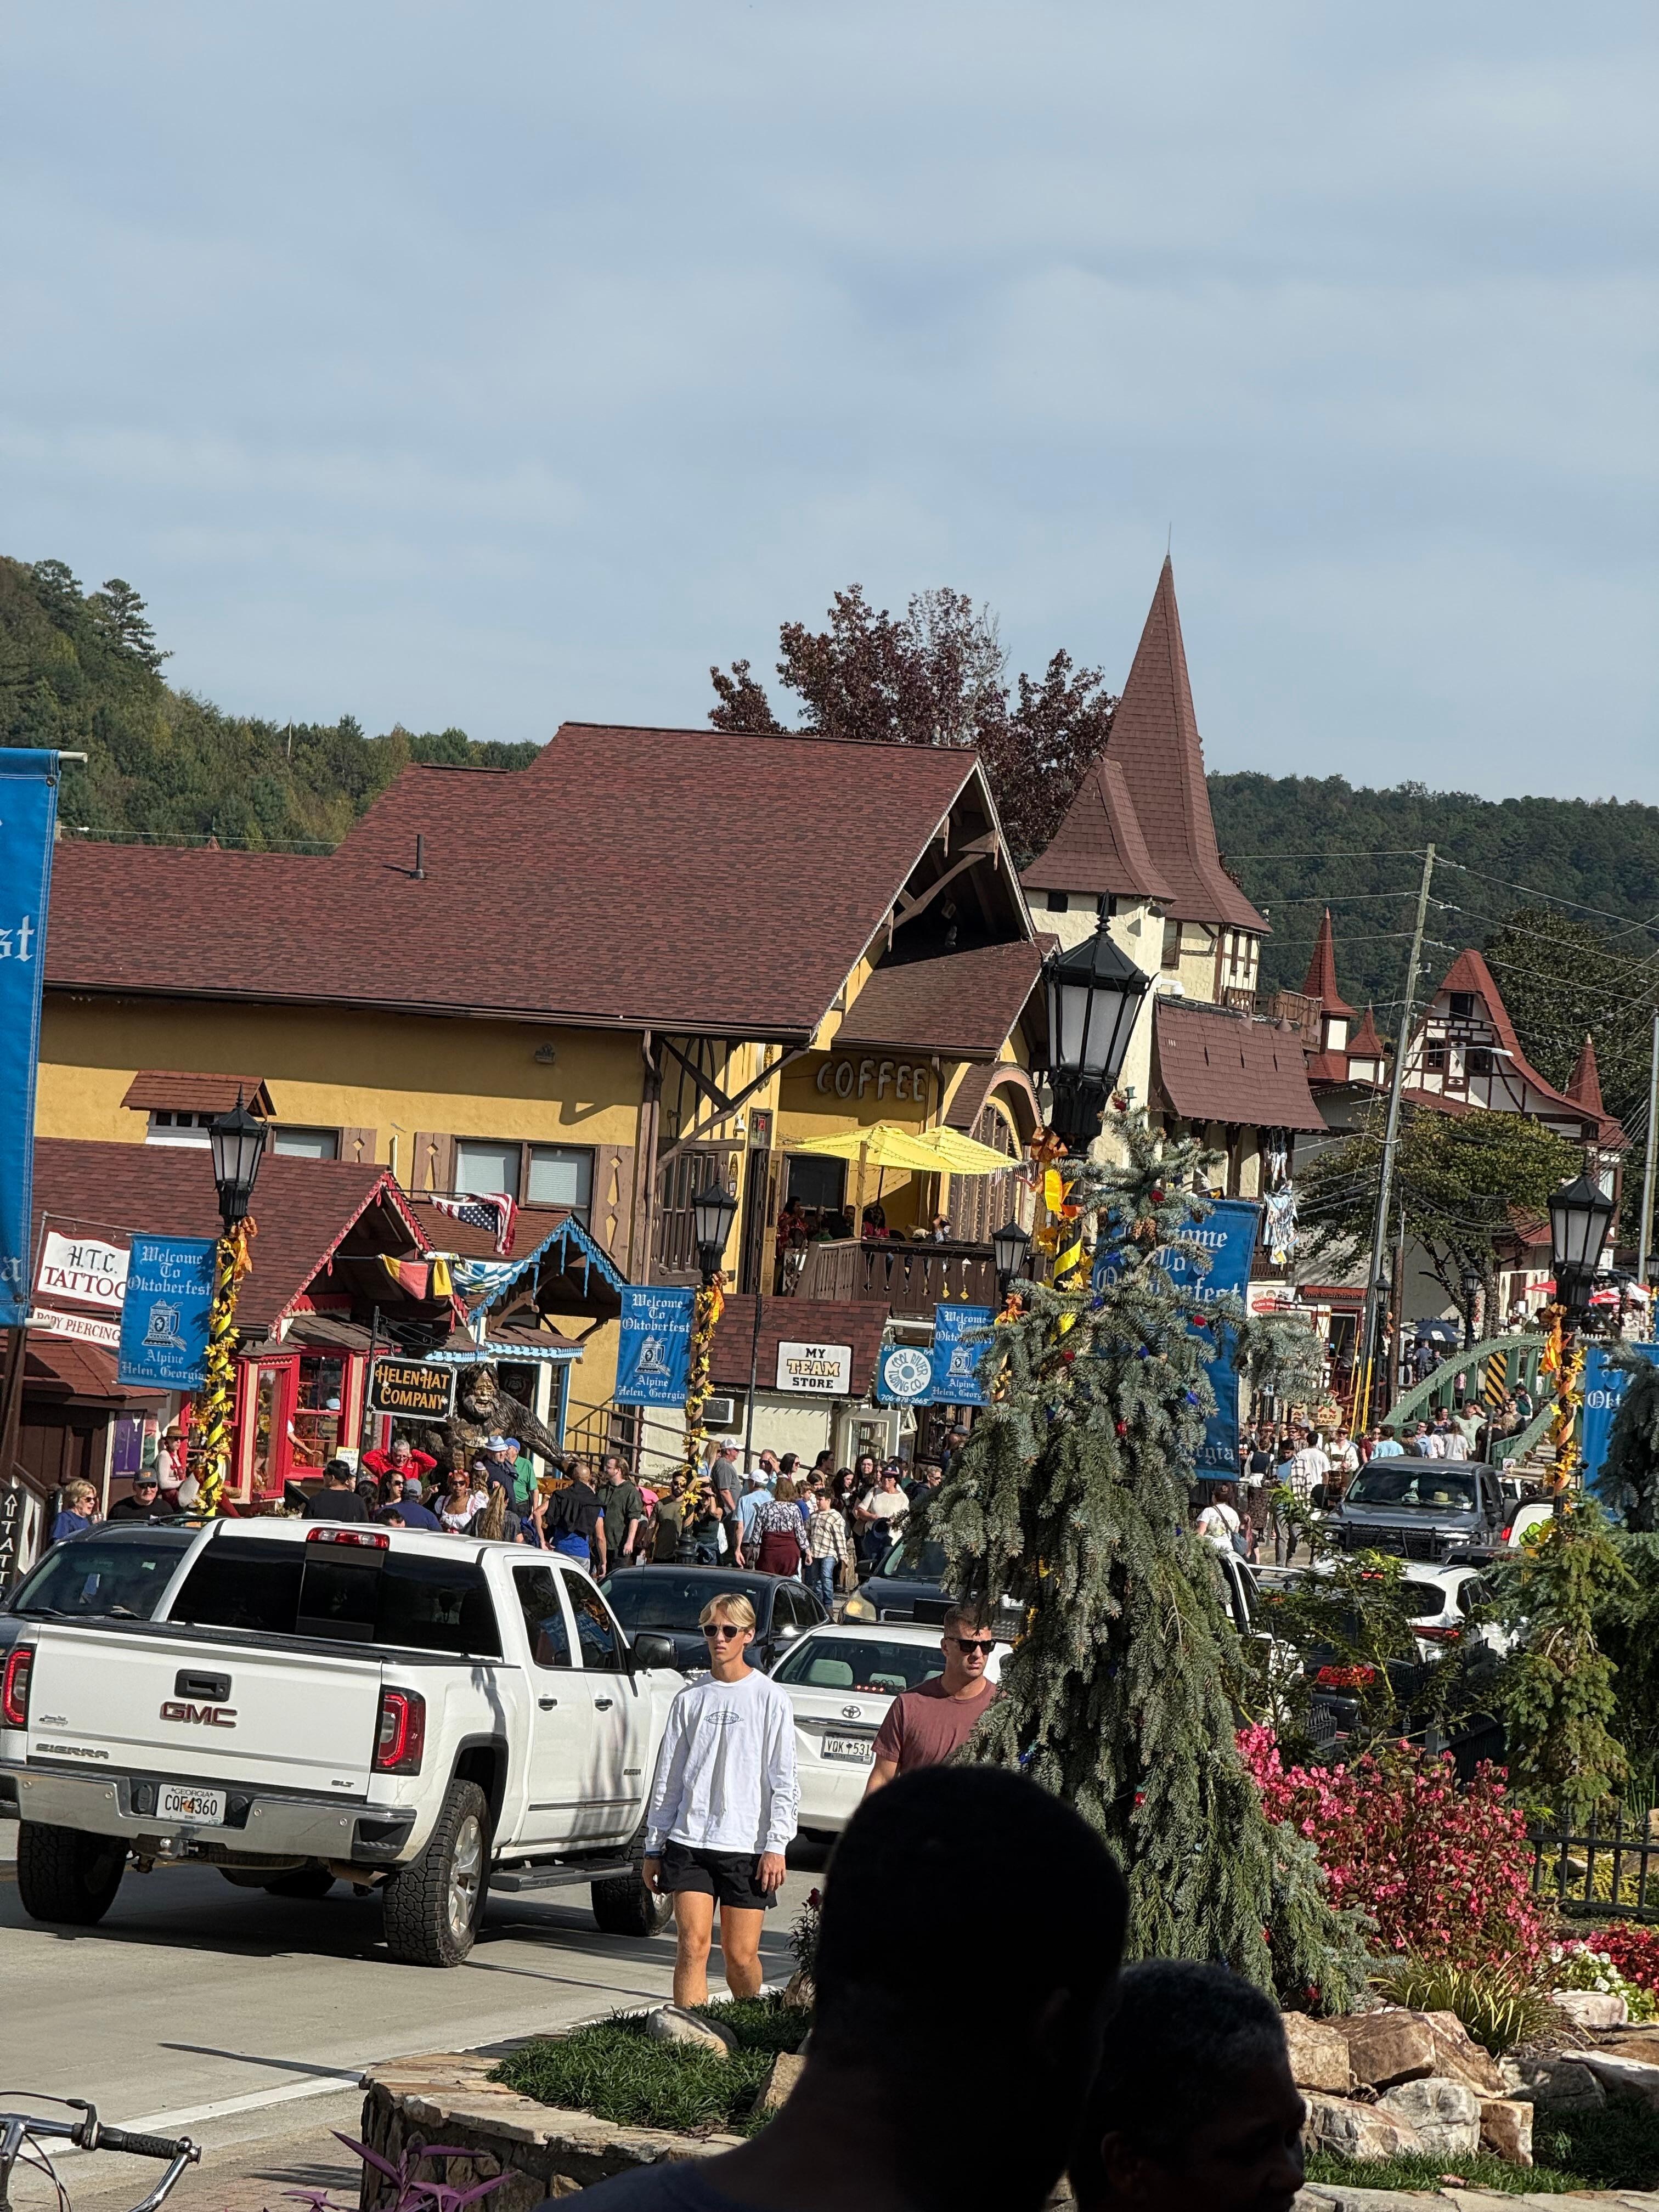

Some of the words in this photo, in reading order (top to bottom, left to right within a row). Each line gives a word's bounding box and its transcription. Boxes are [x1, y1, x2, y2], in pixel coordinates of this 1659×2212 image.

[817, 1060, 927, 1102] COFFEE
[67, 1245, 117, 1274] H.T.C.
[140, 1246, 203, 1265] Welcome
[160, 1262, 181, 1278] To
[127, 1275, 212, 1296] Oktoberfest
[631, 1294, 683, 1310] Welcome
[648, 1306, 665, 1319] To
[944, 1311, 987, 1323] Welcome
[65, 1319, 121, 1341] PIERCING
[622, 1317, 690, 1333] Oktoberfest
[144, 1349, 184, 1365] Alpine
[805, 1348, 826, 1359] MY
[121, 1361, 157, 1378] Helen,
[160, 1365, 205, 1383] Georgia
[787, 1358, 840, 1377] TEAM
[891, 1352, 909, 1368] COOL
[910, 1353, 929, 1376] RIVER
[375, 1364, 420, 1386] HELEN
[420, 1370, 450, 1390] HAT
[636, 1375, 668, 1388] Alpine
[792, 1377, 833, 1389] STORE
[888, 1369, 909, 1393] TUBING
[910, 1378, 925, 1392] CO.
[947, 1378, 975, 1390] Alpine
[380, 1387, 445, 1410] COMPANY
[618, 1385, 646, 1398] Helen,
[648, 1387, 685, 1402] Georgia
[932, 1386, 957, 1398] Helen,
[958, 1389, 984, 1401] Georg
[160, 1701, 238, 1728] GMC
[36, 1743, 110, 1759] SIERRA
[827, 1740, 844, 1753] VQK
[853, 1742, 870, 1756] 531
[174, 1788, 210, 1798] GEORGIA
